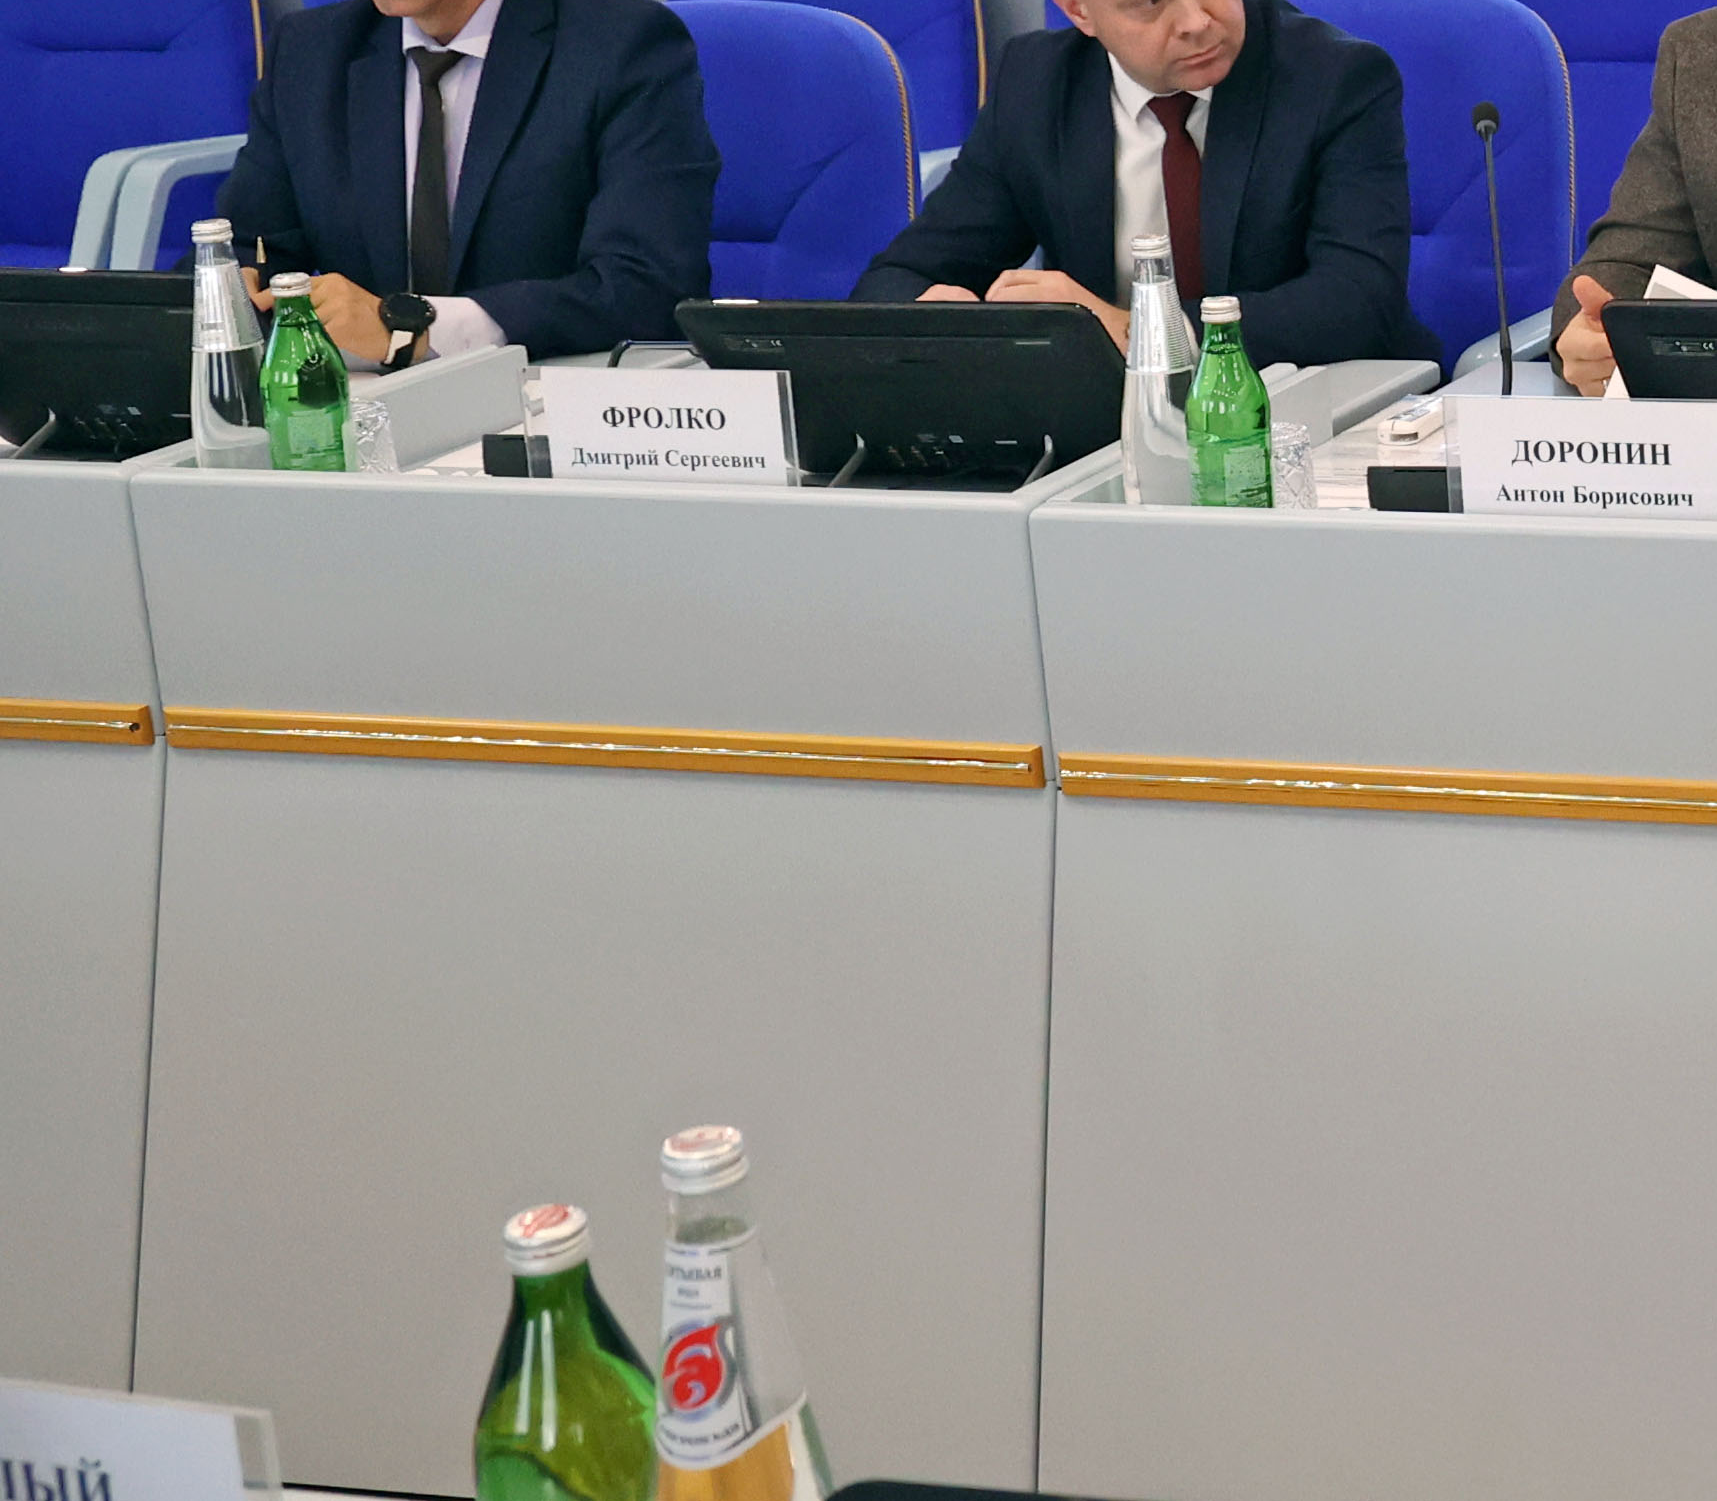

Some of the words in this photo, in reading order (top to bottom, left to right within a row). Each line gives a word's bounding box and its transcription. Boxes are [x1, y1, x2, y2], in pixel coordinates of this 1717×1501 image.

[602, 405, 726, 431] ФРОЛКО
[571, 447, 659, 470] Дмитрий
[664, 449, 766, 472] Сергеевич
[1511, 440, 1671, 467] ДОРОНИН
[1496, 484, 1566, 503] Антон
[1573, 485, 1694, 510] Борисович
